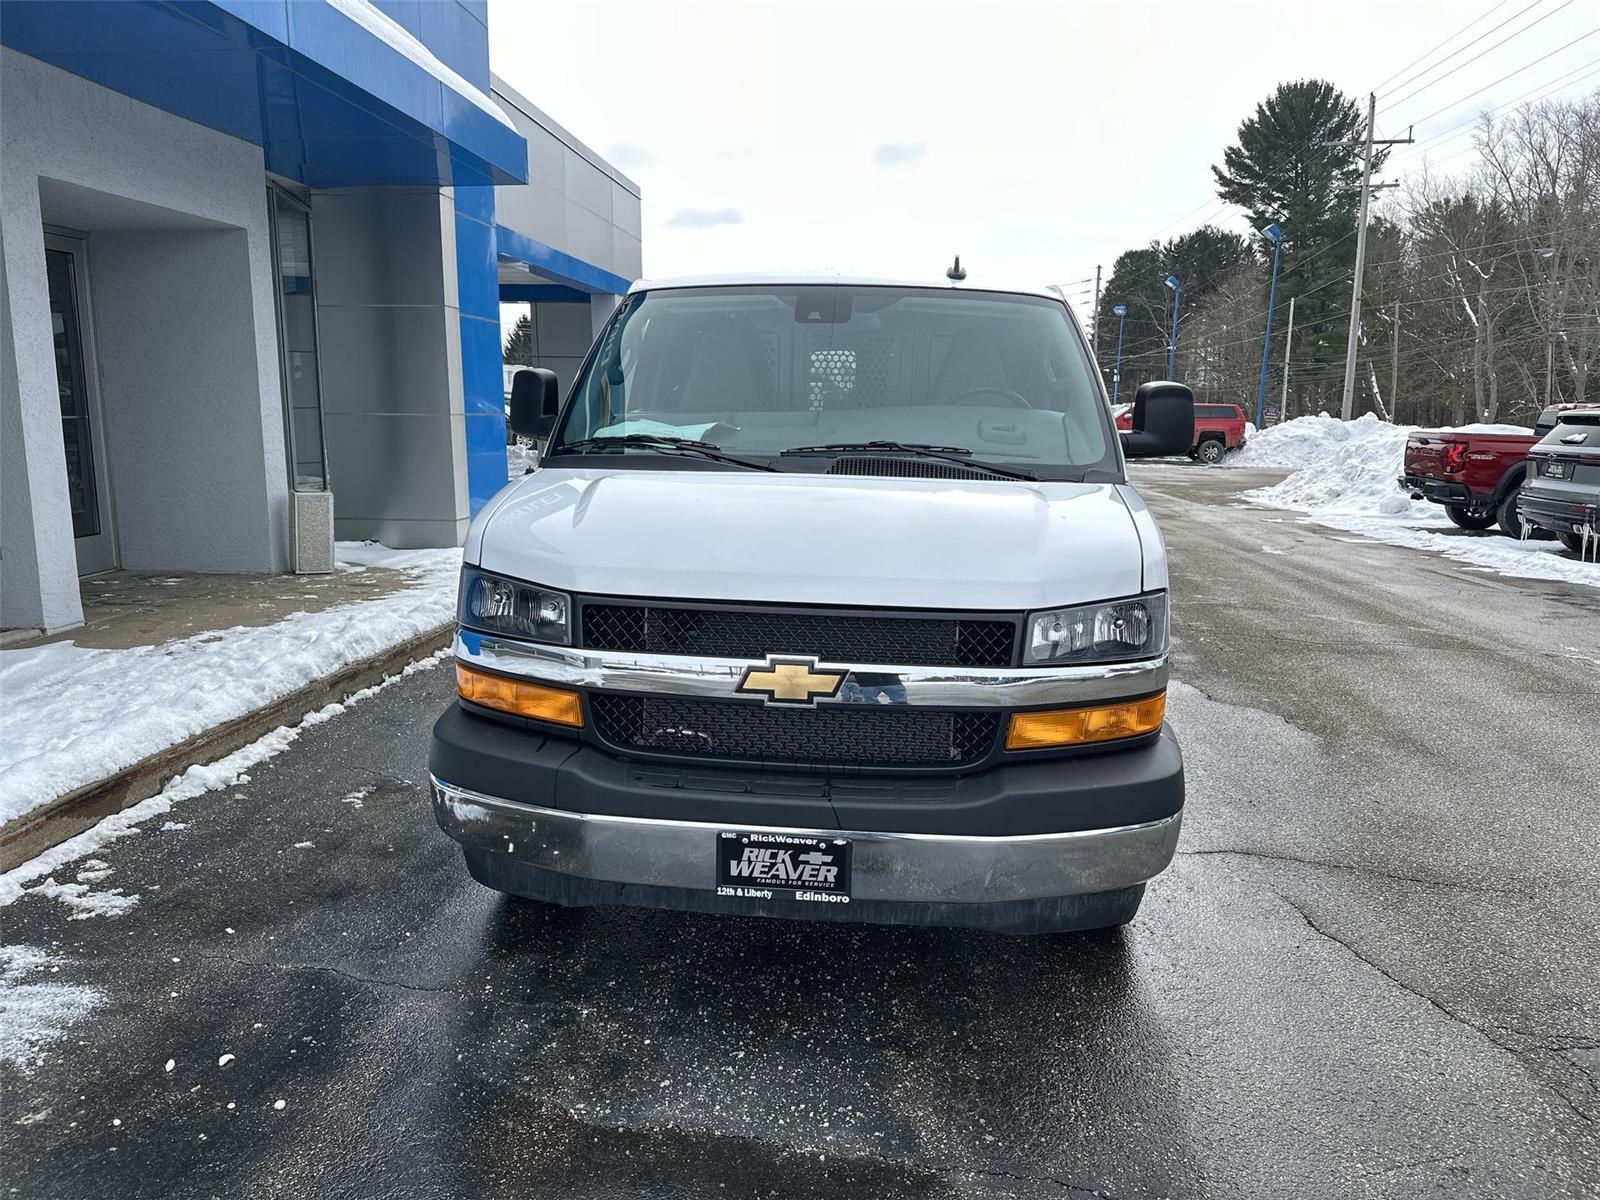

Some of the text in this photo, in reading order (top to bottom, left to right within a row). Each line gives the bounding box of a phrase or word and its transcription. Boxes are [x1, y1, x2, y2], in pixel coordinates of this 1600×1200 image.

[742, 847, 794, 863] RICK
[730, 859, 838, 883] WEAVER
[716, 887, 735, 896] 12th
[744, 888, 773, 900] Liberty
[795, 891, 850, 904] Edinboro
